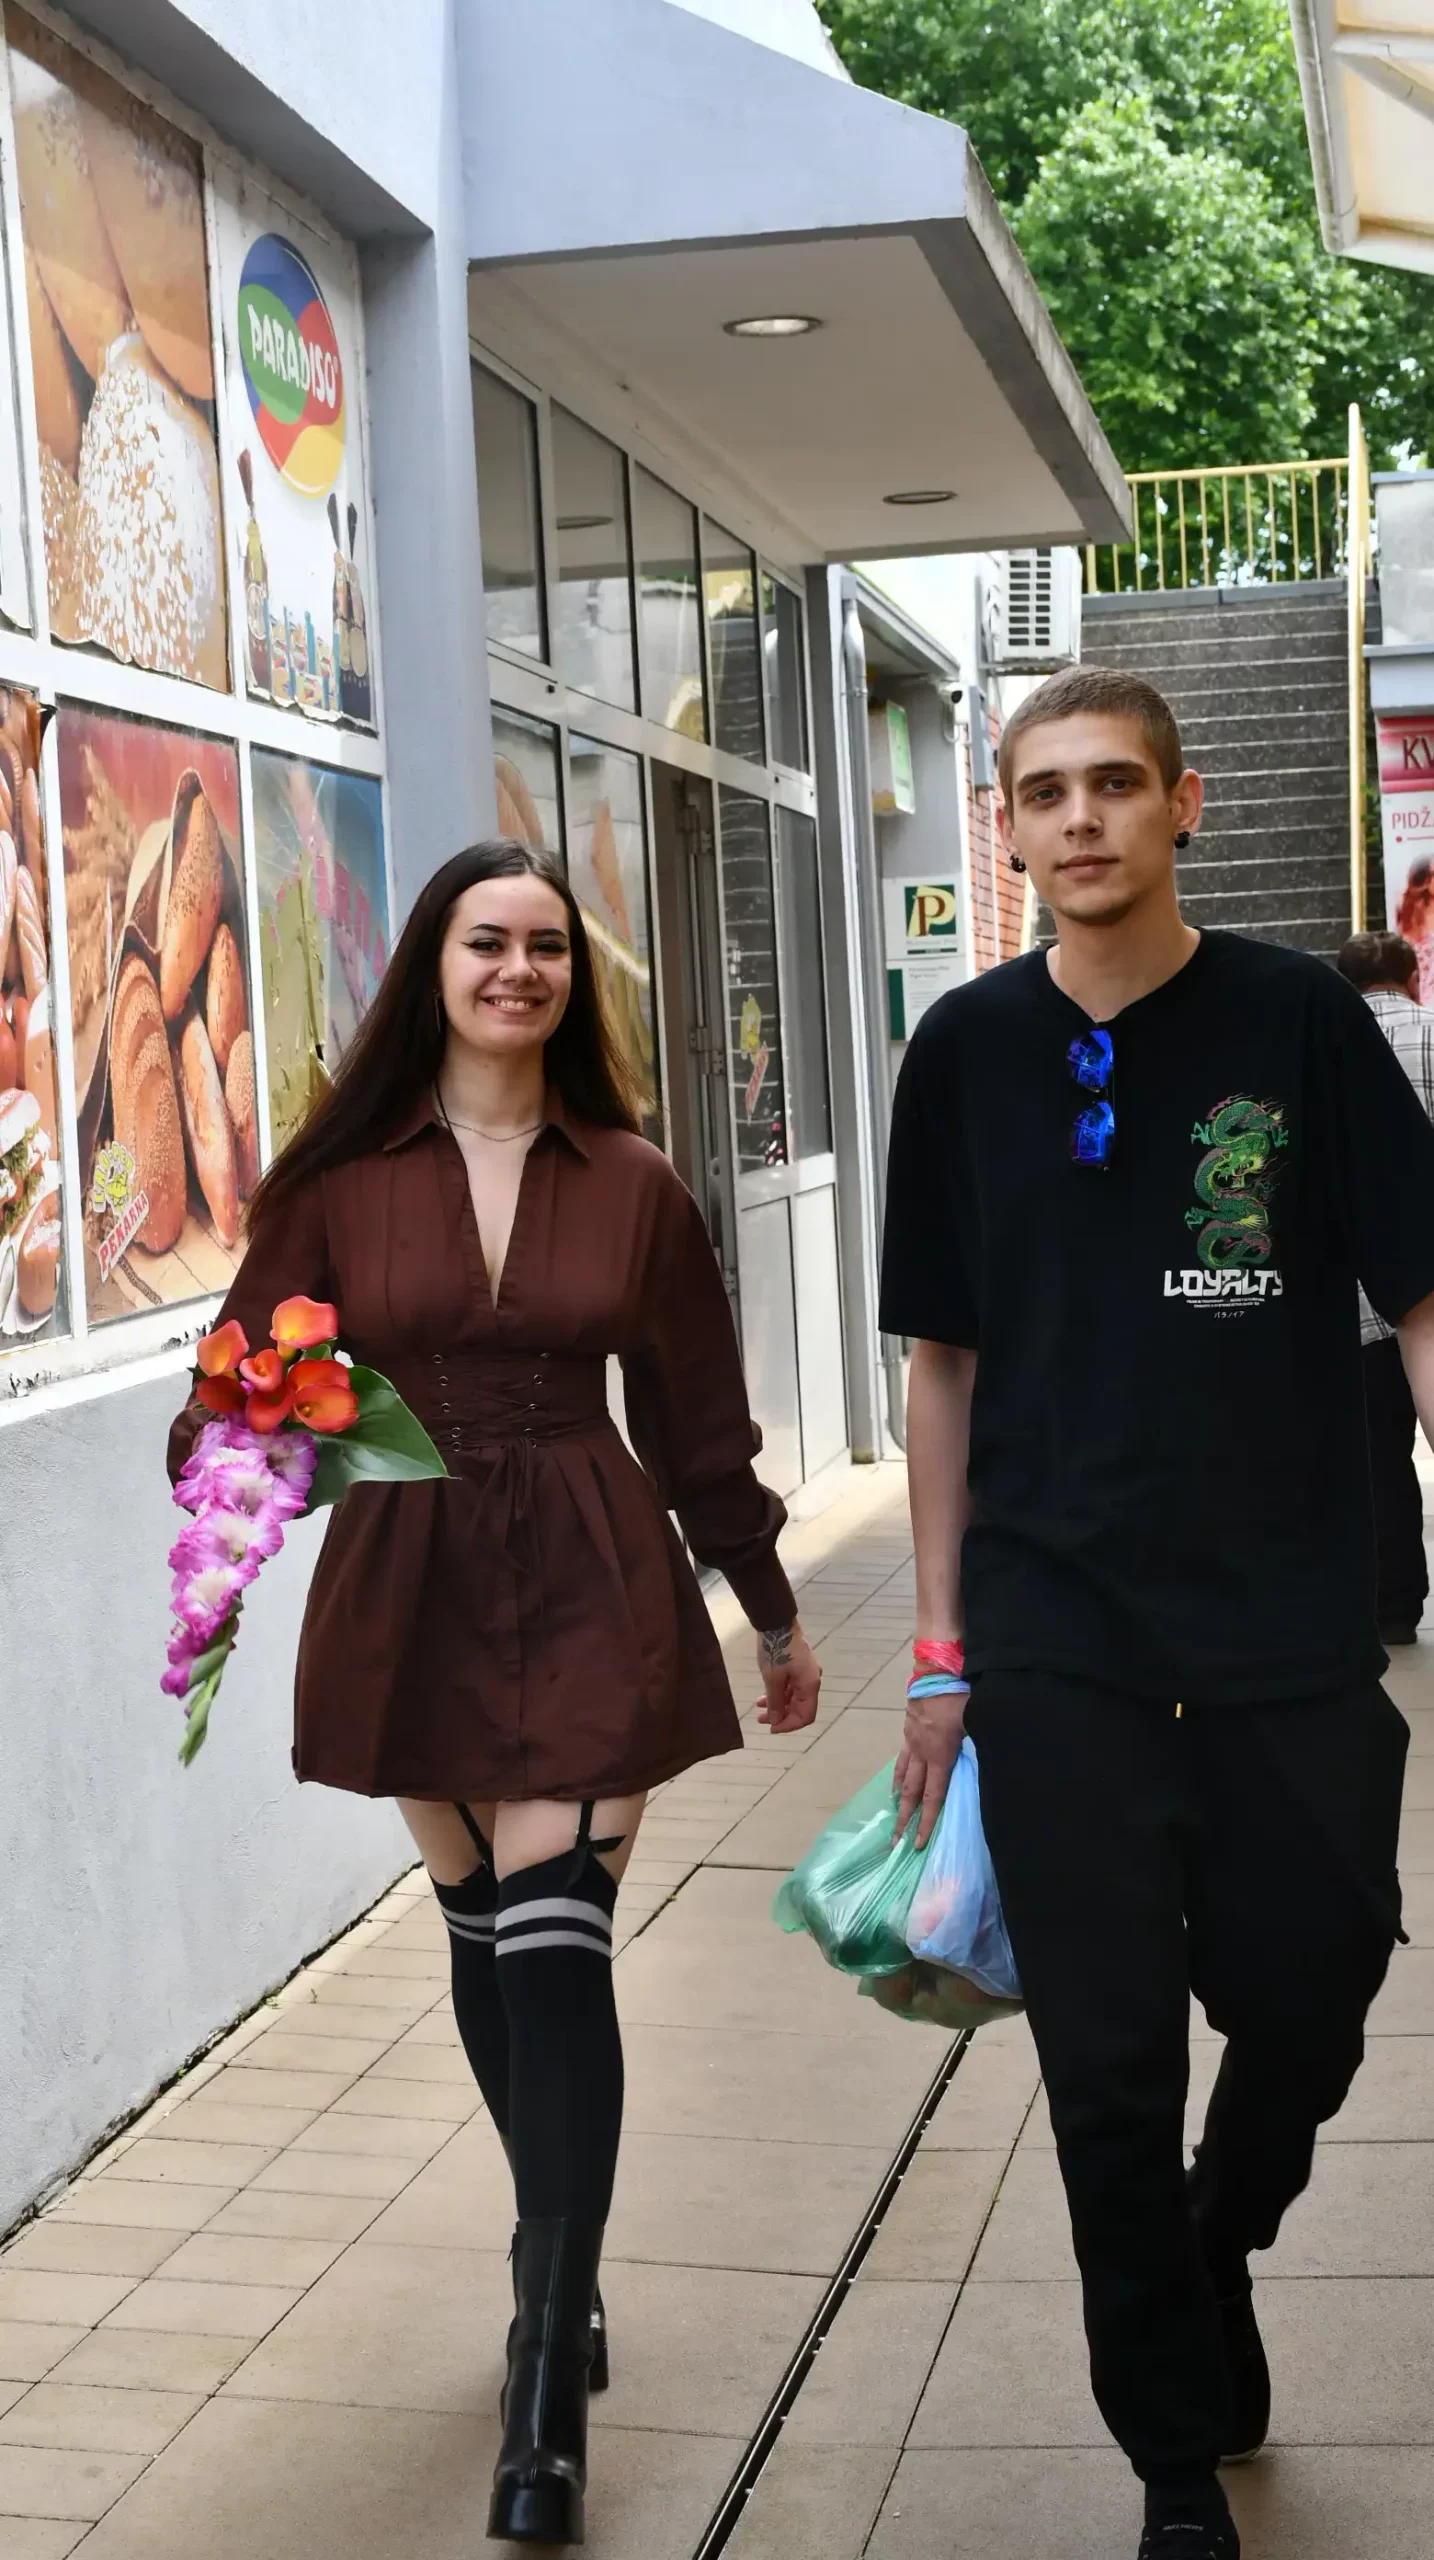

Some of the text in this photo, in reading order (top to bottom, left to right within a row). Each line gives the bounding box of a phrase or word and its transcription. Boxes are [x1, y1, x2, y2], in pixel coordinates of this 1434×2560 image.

[247, 304, 336, 409] PARADISO
[1391, 806, 1434, 829] PIDŽ
[99, 1192, 148, 1272] PEKARNA
[1163, 1268, 1283, 1297] LOYALTY
